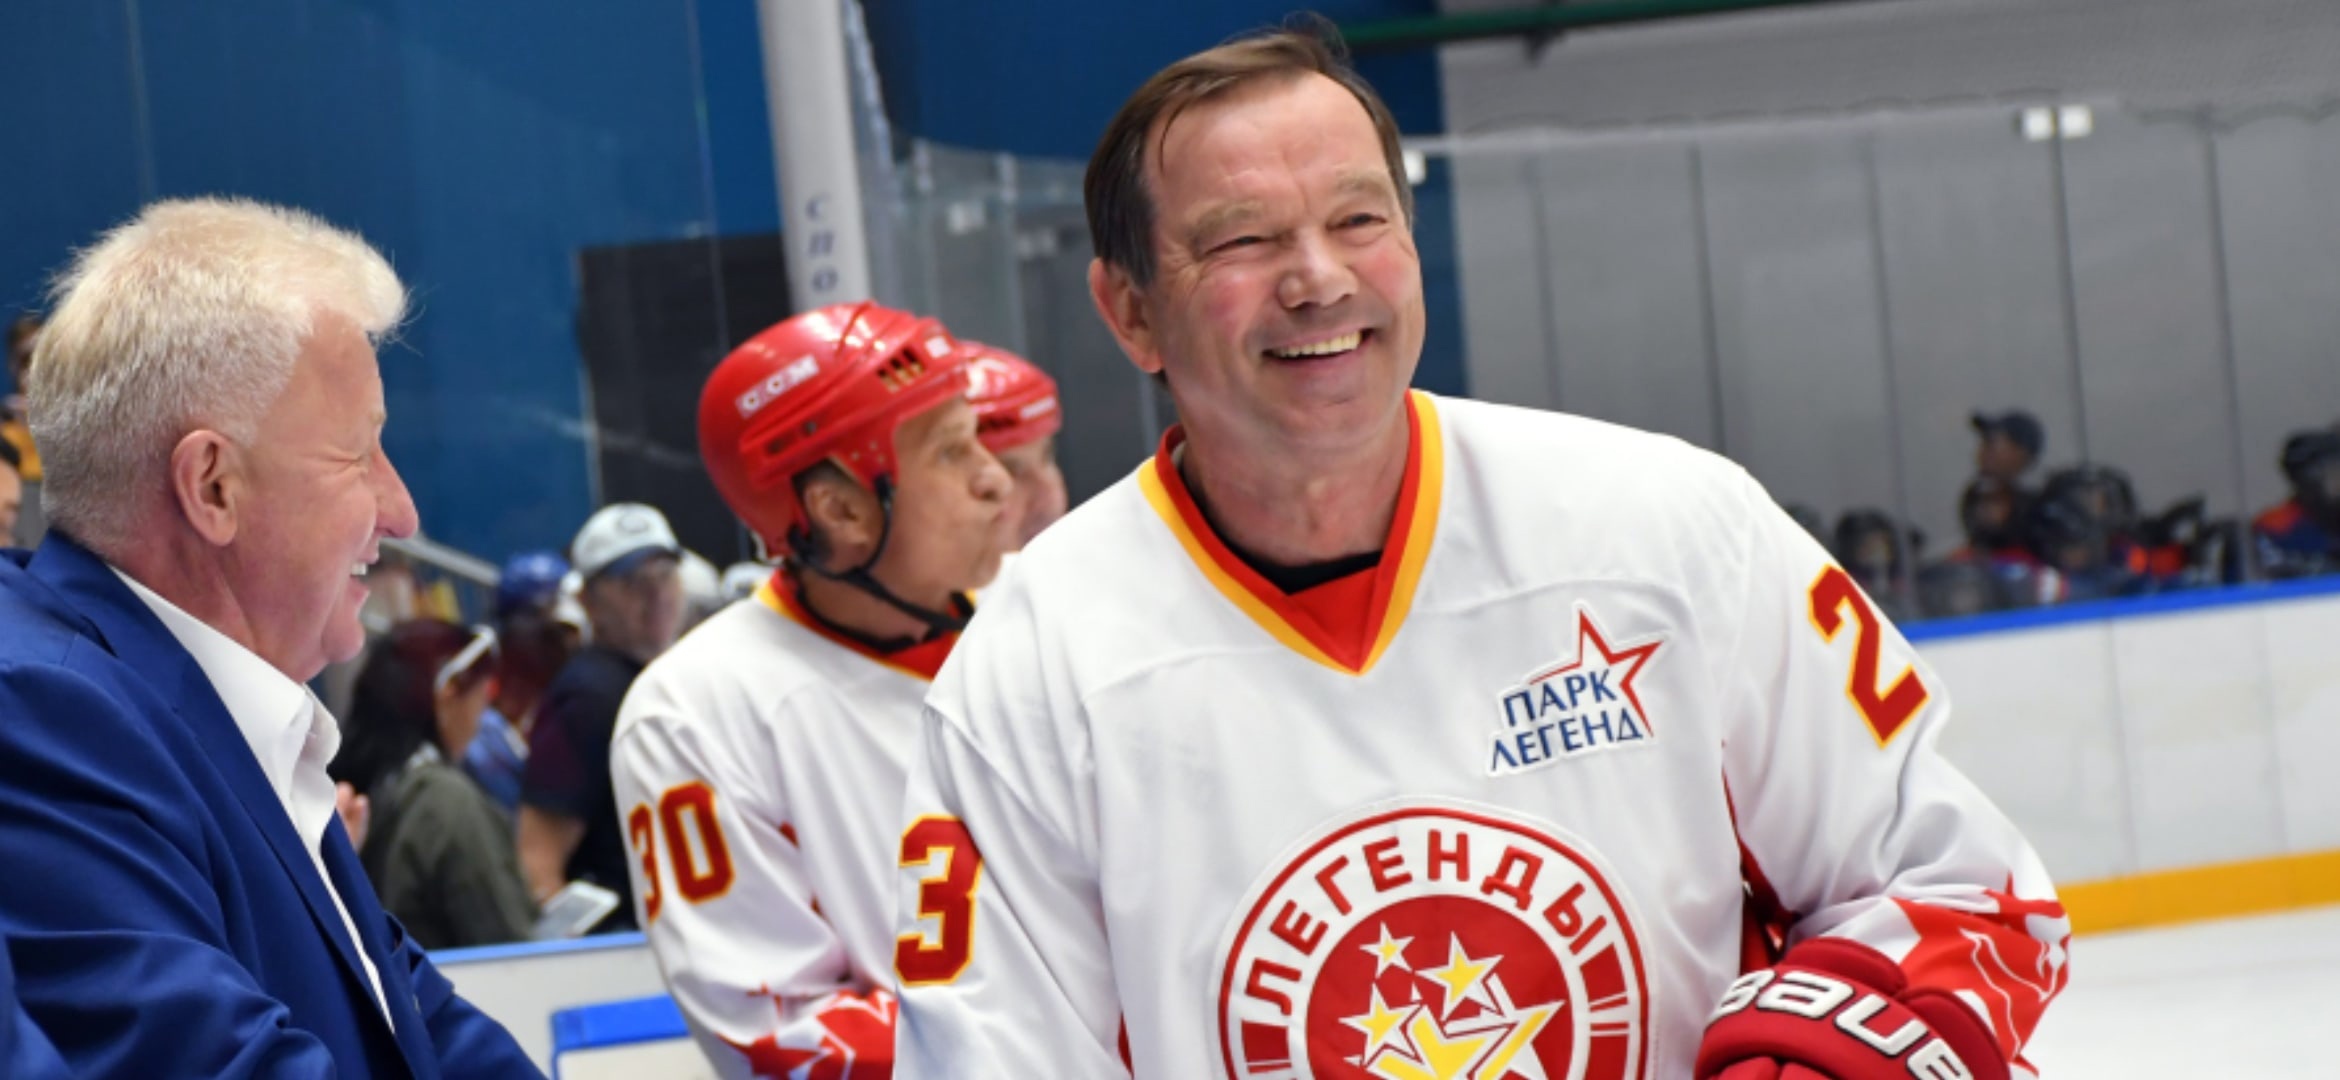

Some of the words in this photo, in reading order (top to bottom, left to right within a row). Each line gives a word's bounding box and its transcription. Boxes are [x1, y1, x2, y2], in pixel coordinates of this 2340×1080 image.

[1503, 668, 1617, 727] ПАРК
[1806, 562, 1931, 751] 2
[1491, 707, 1643, 771] ЛЕГЕНД
[628, 780, 736, 926] 30
[893, 813, 985, 988] 3
[1244, 829, 1607, 1016] ЛЕГЕНДЫ
